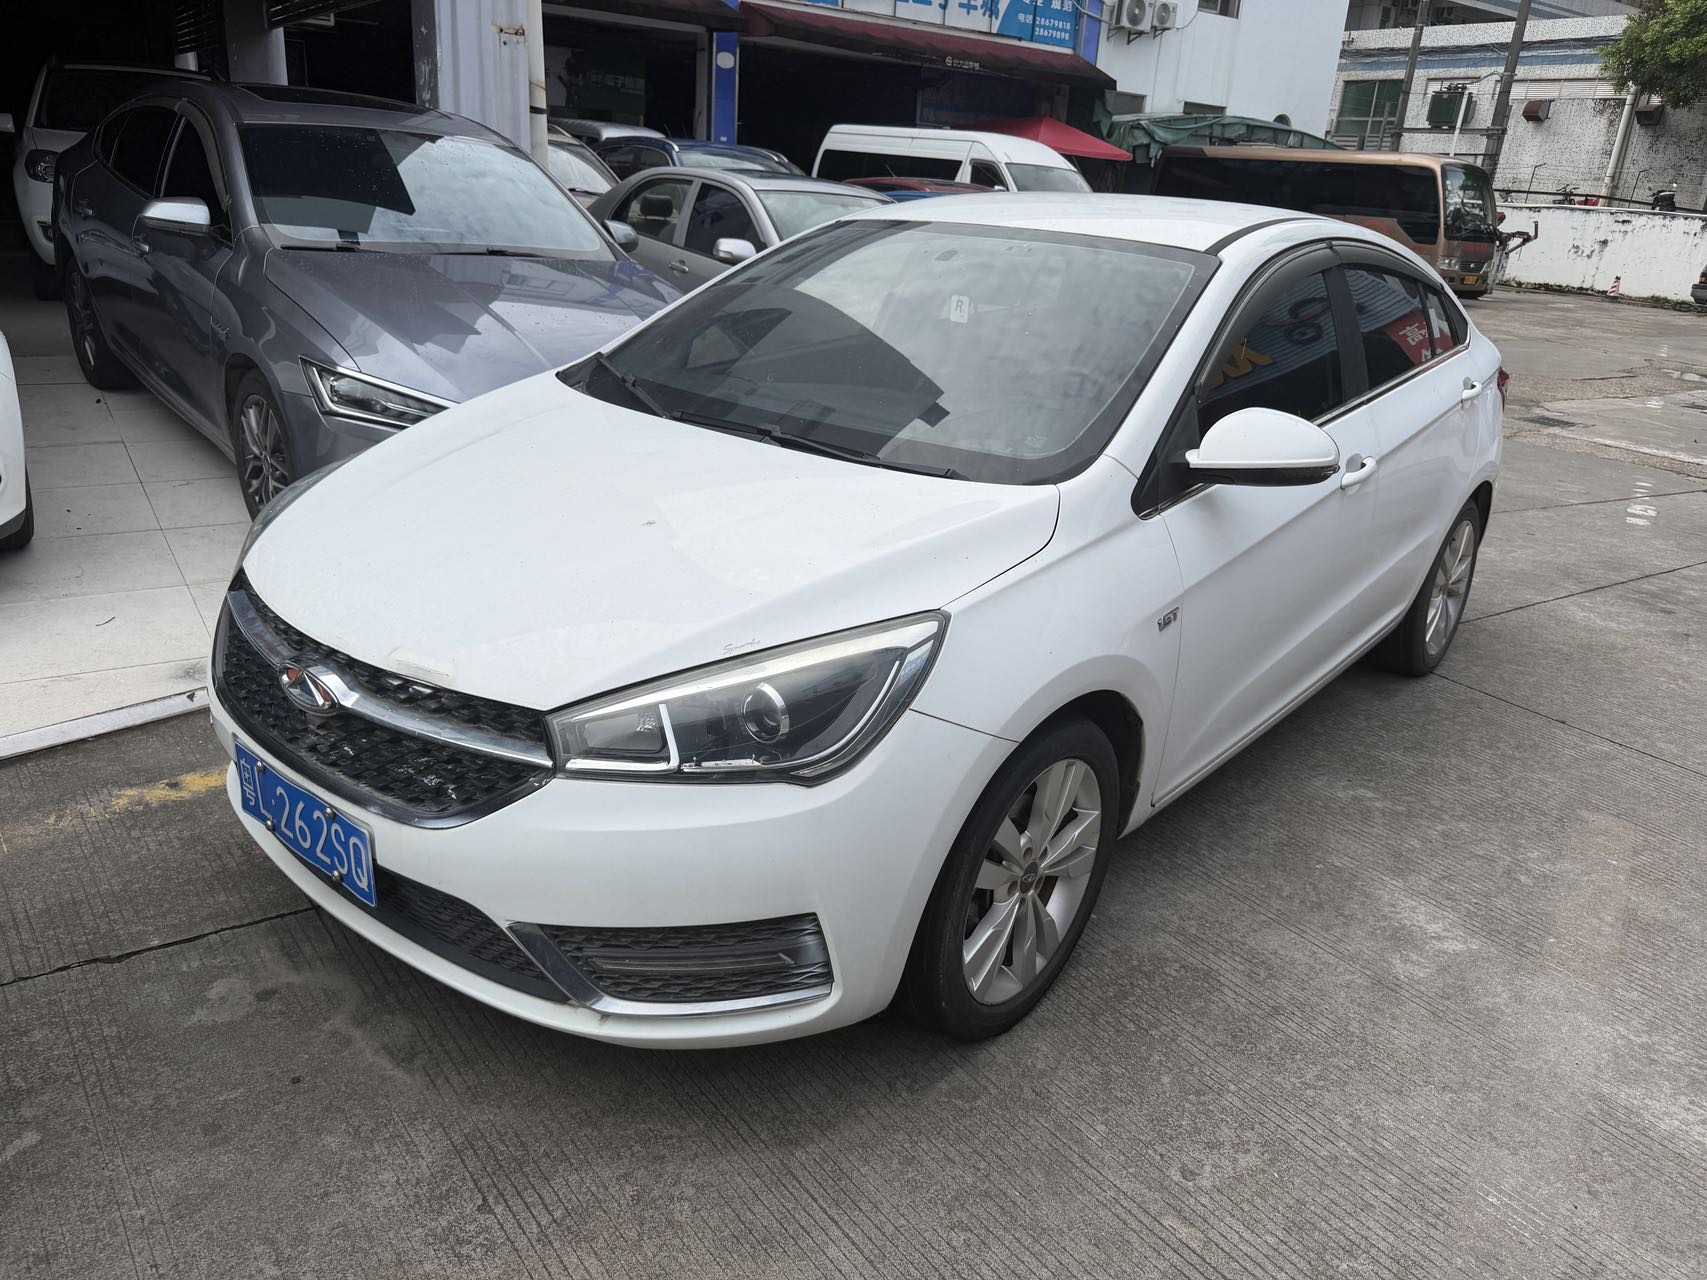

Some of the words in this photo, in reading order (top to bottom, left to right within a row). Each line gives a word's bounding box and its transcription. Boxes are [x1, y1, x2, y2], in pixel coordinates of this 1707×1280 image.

[1017, 13, 1033, 24] 电话
[1035, 17, 1071, 30] 28679818
[1035, 28, 1070, 40] 28679898
